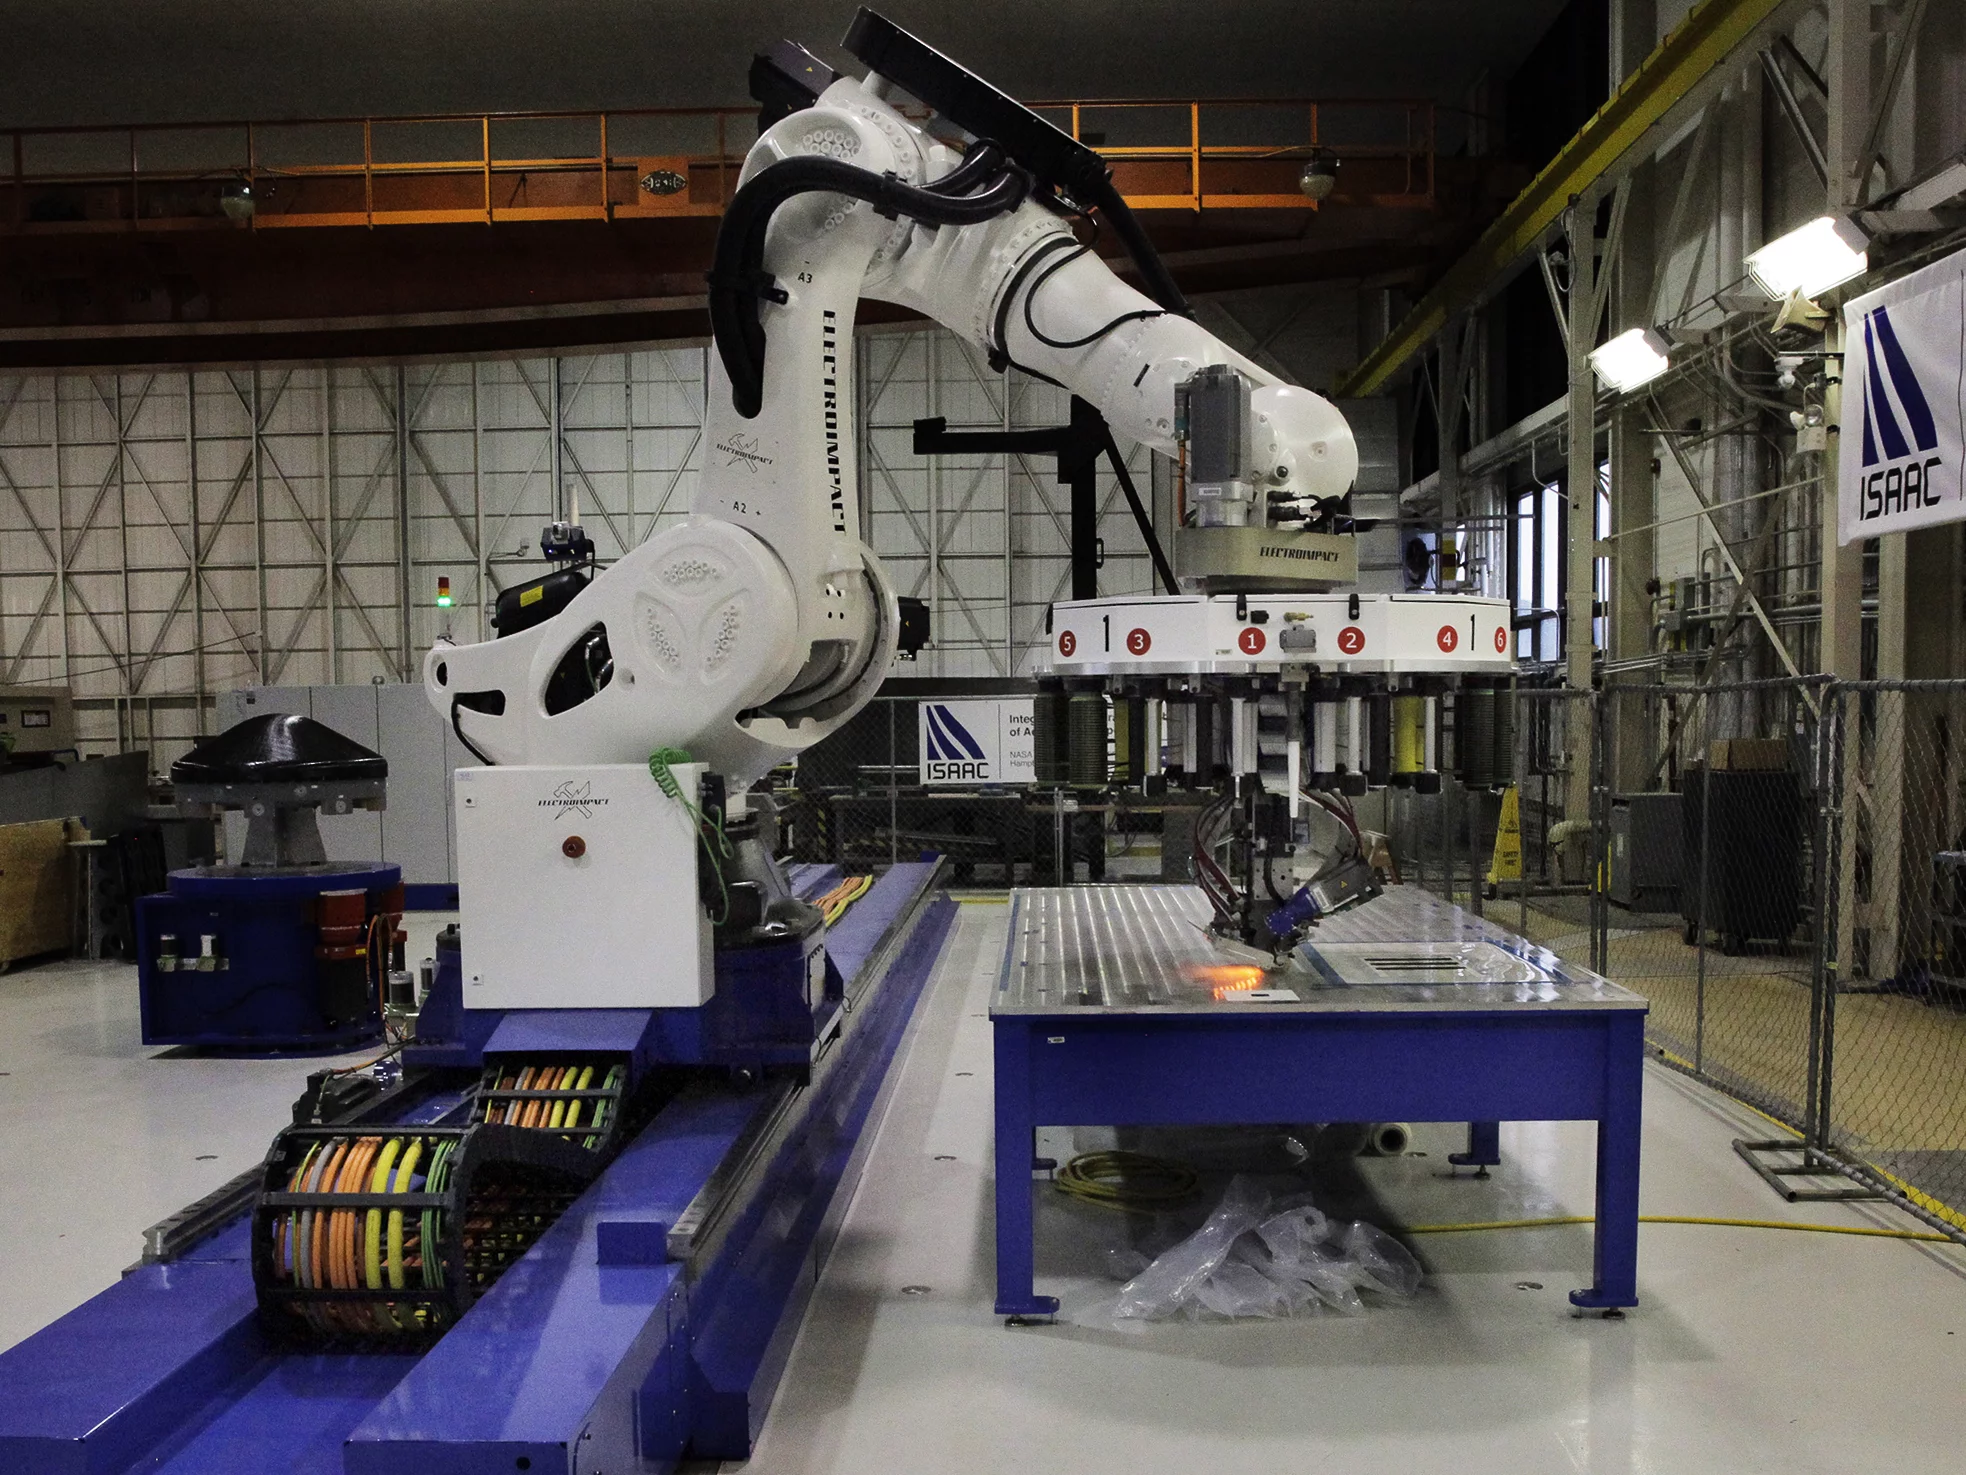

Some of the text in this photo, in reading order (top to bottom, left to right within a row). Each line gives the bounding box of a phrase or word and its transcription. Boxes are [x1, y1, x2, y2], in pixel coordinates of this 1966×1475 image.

[797, 272, 813, 284] A3
[823, 310, 847, 537] ELECTROIMPACT
[1860, 456, 1942, 521] ISAAC
[733, 501, 747, 514] A2
[1260, 547, 1339, 562] ELECTROIMPACT
[1064, 636, 1072, 652] 5
[1134, 634, 1144, 650] 3
[1247, 633, 1257, 649] 1
[1346, 632, 1357, 648] 2
[1443, 632, 1452, 646] 4
[1497, 633, 1503, 647] 6
[1009, 727, 1021, 737] of
[1009, 751, 1033, 759] NASA
[927, 762, 989, 780] ISAAC
